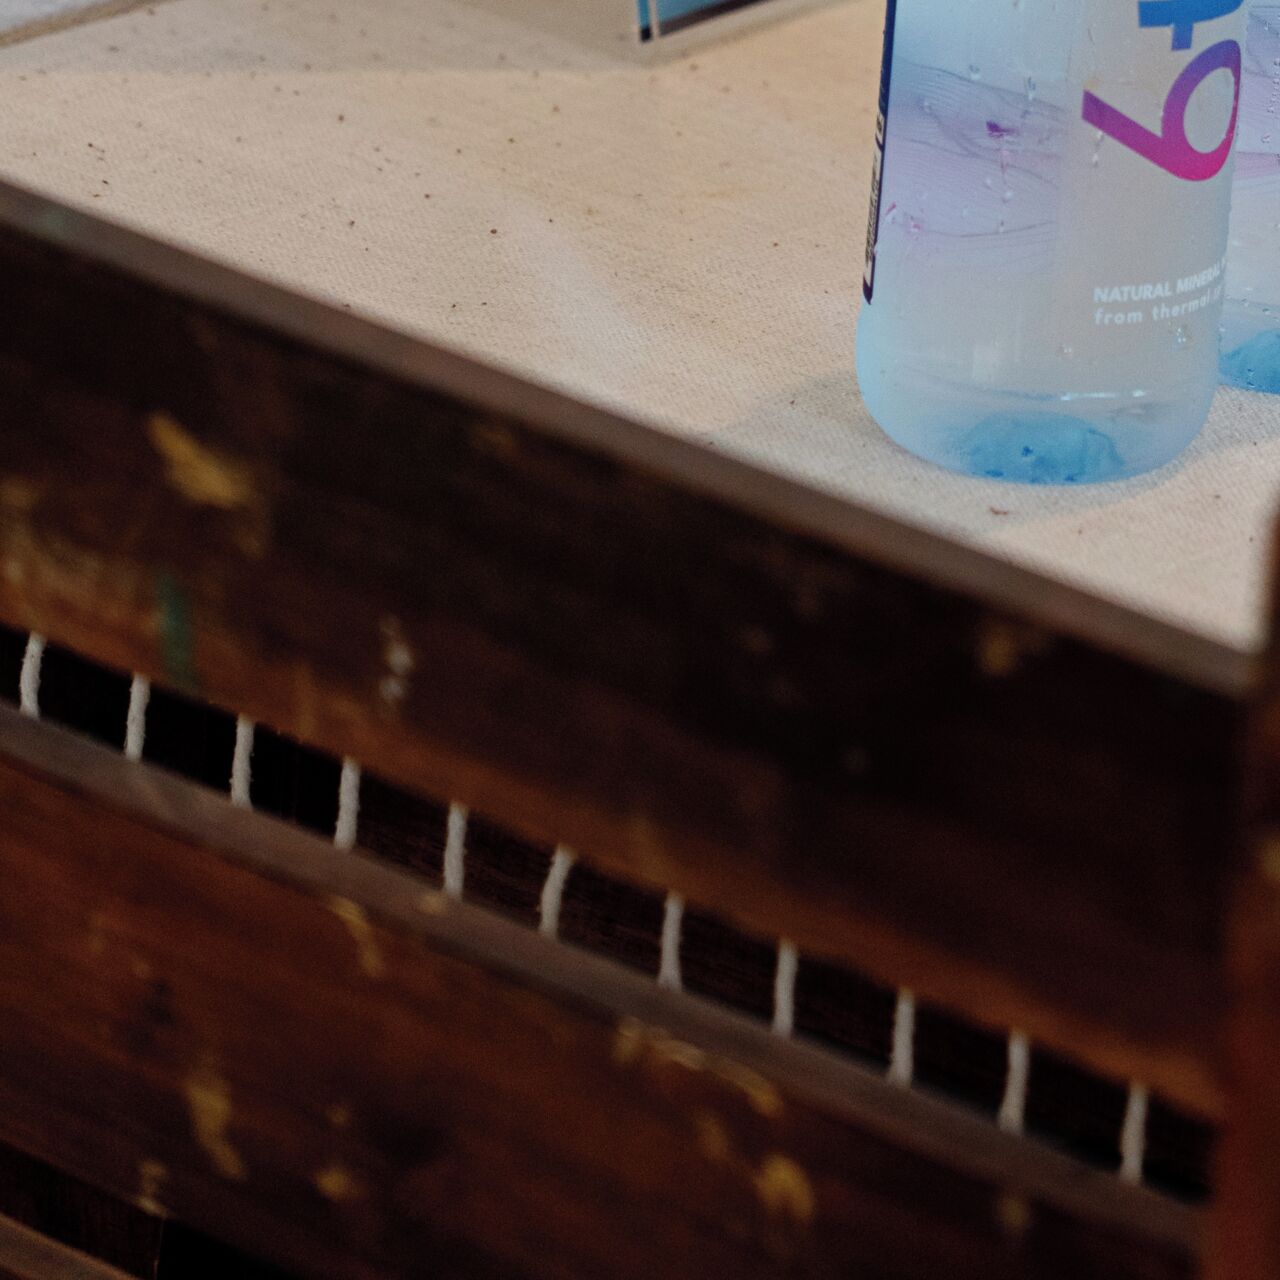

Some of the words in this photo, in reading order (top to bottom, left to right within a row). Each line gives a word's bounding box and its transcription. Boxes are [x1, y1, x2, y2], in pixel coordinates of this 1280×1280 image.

[1093, 280, 1173, 303] NATURAL
[1094, 307, 1143, 325] from
[1151, 288, 1210, 321] thermal
